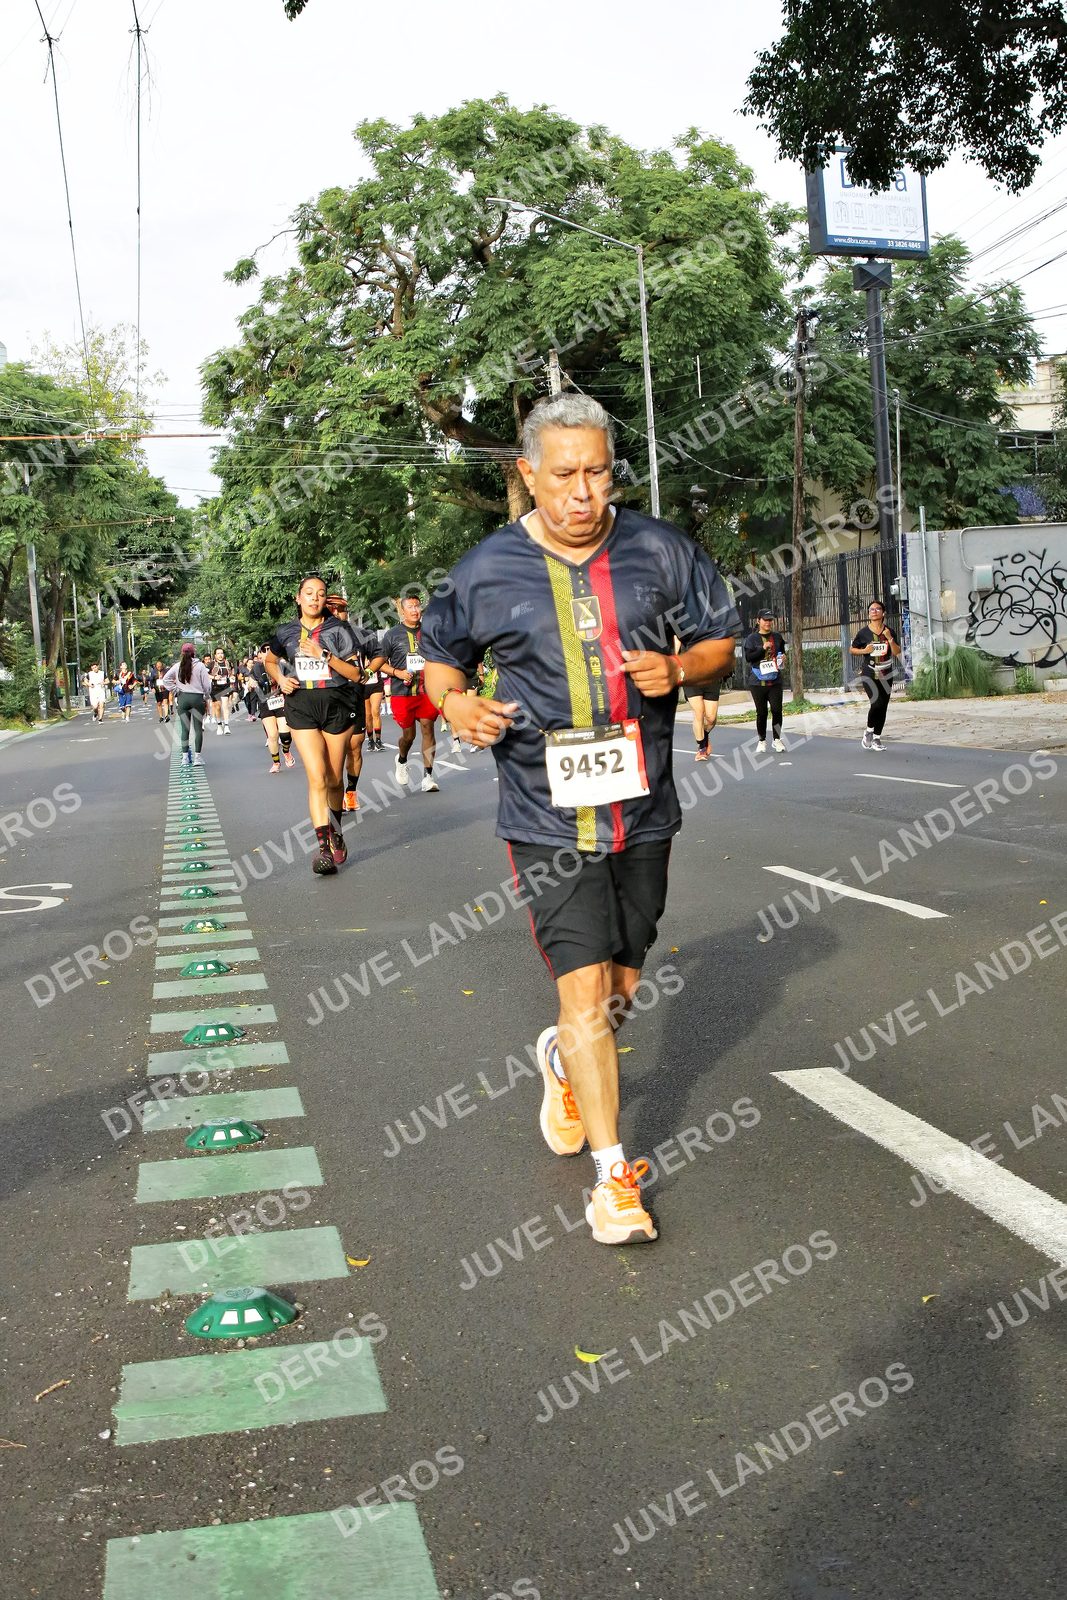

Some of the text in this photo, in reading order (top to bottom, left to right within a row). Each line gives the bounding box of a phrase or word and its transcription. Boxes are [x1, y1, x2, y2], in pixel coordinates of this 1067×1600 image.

[833, 237, 877, 246] www.dibra.com.mx
[993, 548, 1047, 569] TOY
[297, 660, 326, 671] 12857
[559, 749, 625, 781] 9452
